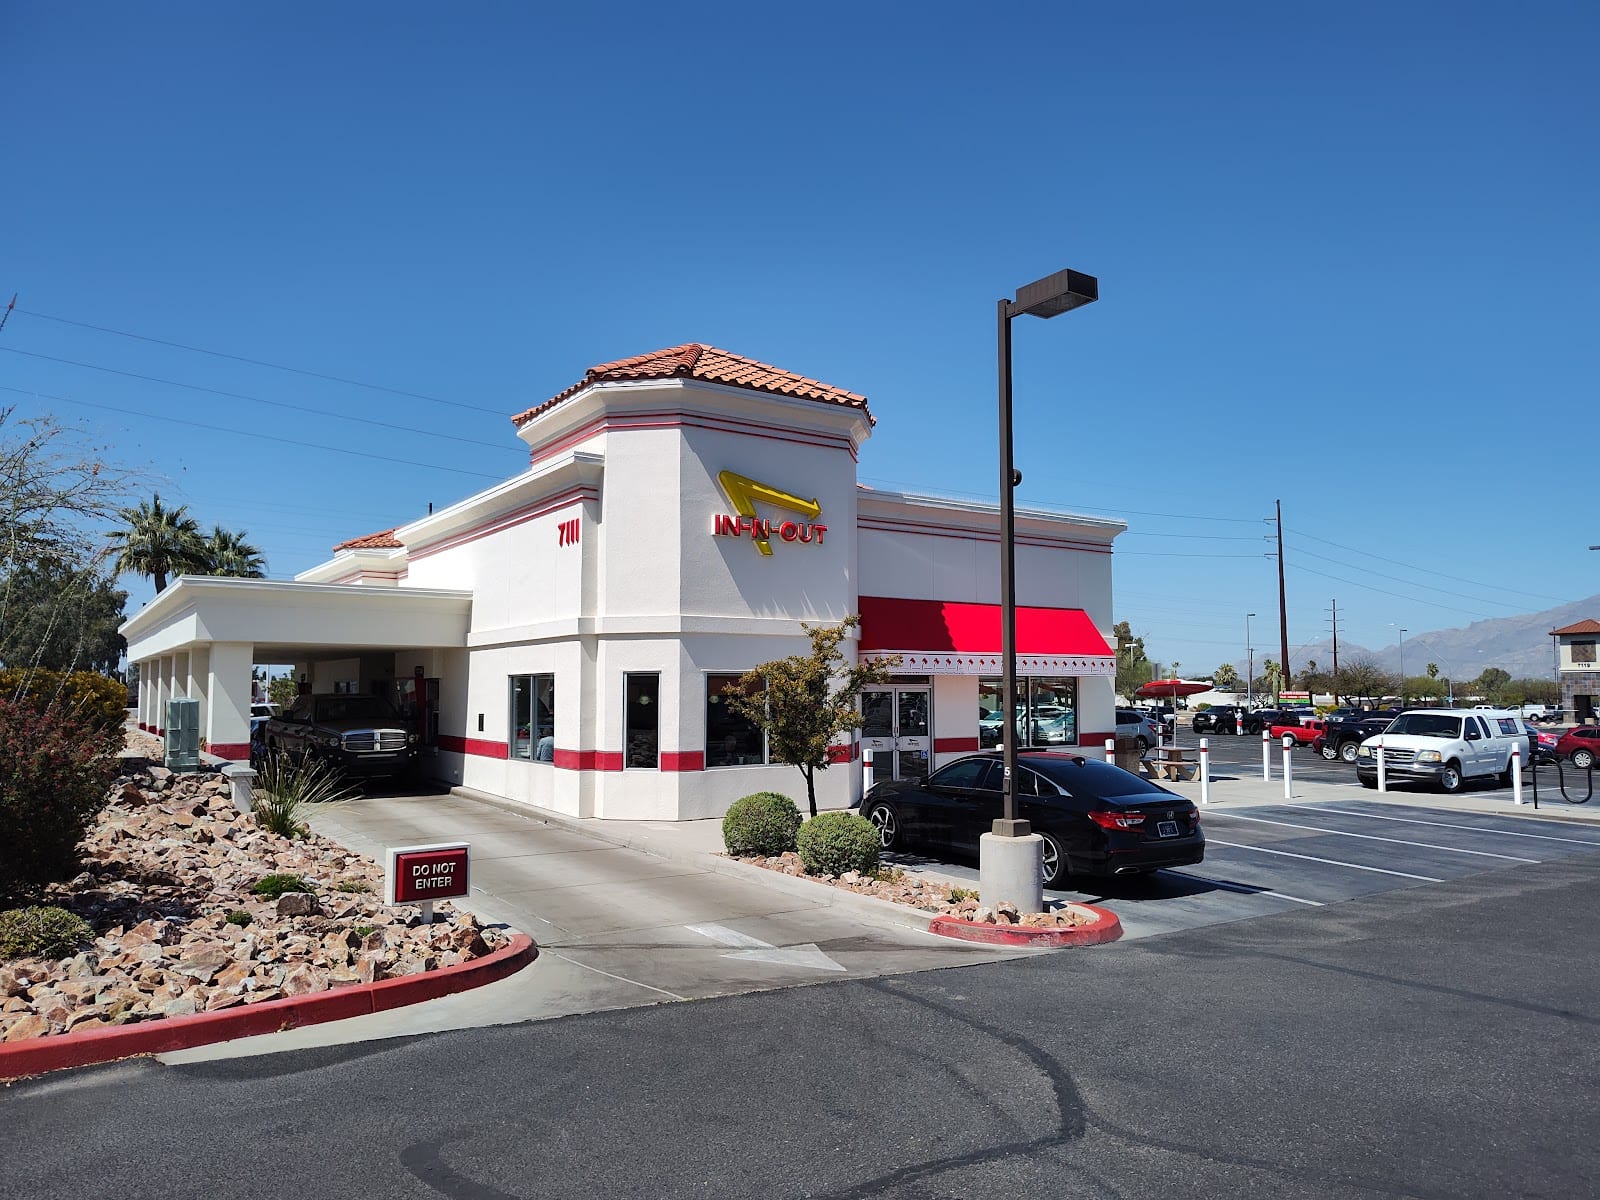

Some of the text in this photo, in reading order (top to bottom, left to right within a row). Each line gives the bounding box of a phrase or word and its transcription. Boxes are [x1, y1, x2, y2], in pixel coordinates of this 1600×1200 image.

[557, 518, 580, 549] 7111
[712, 514, 828, 544] IN-N-OUT
[1004, 767, 1010, 776] 5
[413, 863, 456, 876] DO NOT
[415, 877, 452, 889] ENTER
